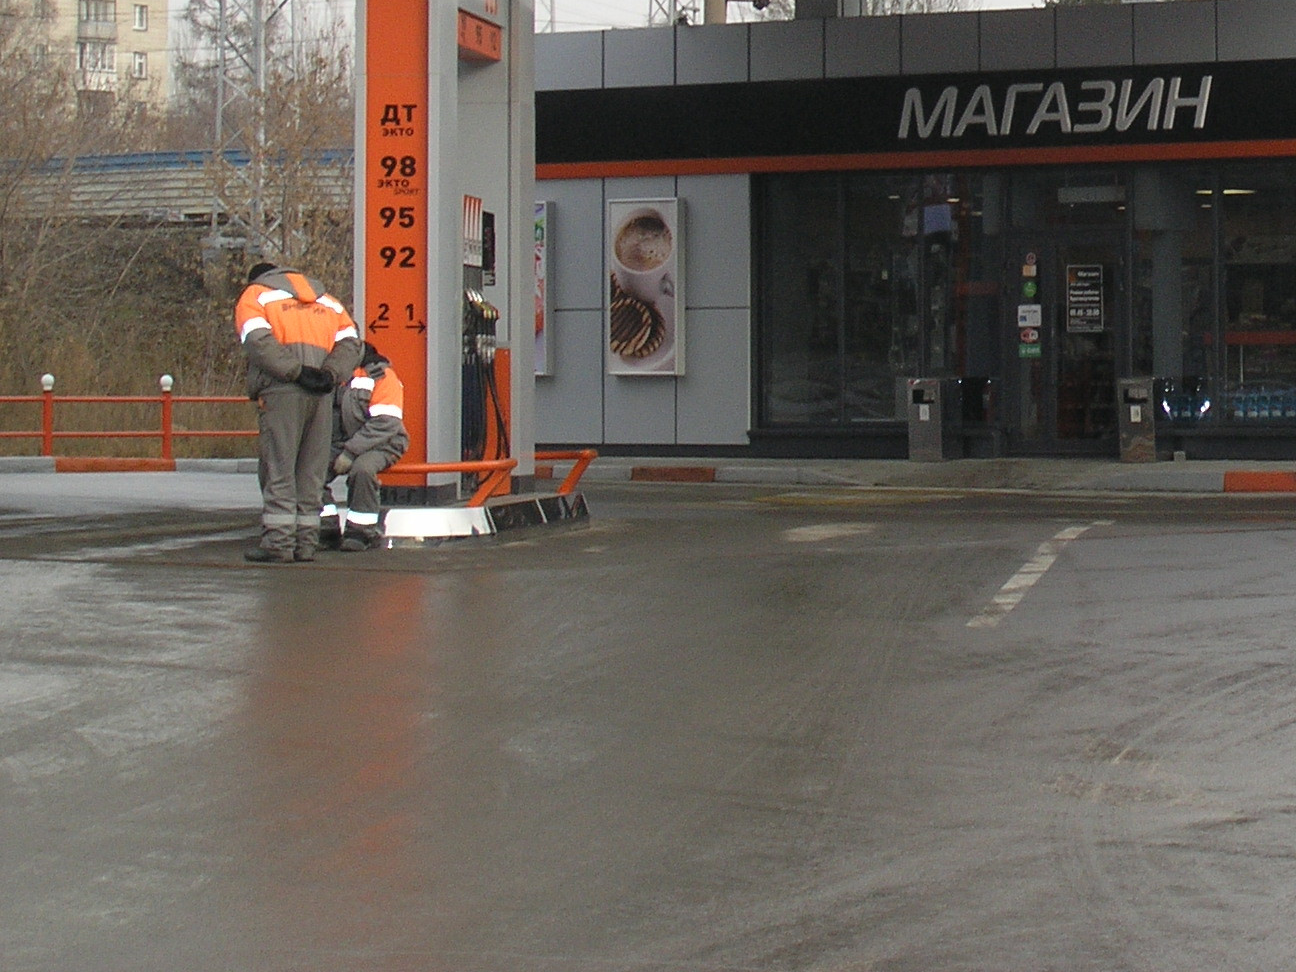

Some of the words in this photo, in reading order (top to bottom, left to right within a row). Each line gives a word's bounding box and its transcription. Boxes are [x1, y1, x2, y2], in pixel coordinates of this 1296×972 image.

[381, 104, 417, 126] ДТ
[898, 75, 1213, 139] МАГАЗИН
[382, 127, 414, 137] ЭКТО
[380, 155, 416, 177] 98
[377, 179, 410, 188] ЭКТО
[379, 206, 415, 228] 95
[380, 246, 416, 268] 92
[378, 303, 389, 321] 2
[405, 303, 414, 321] 1
